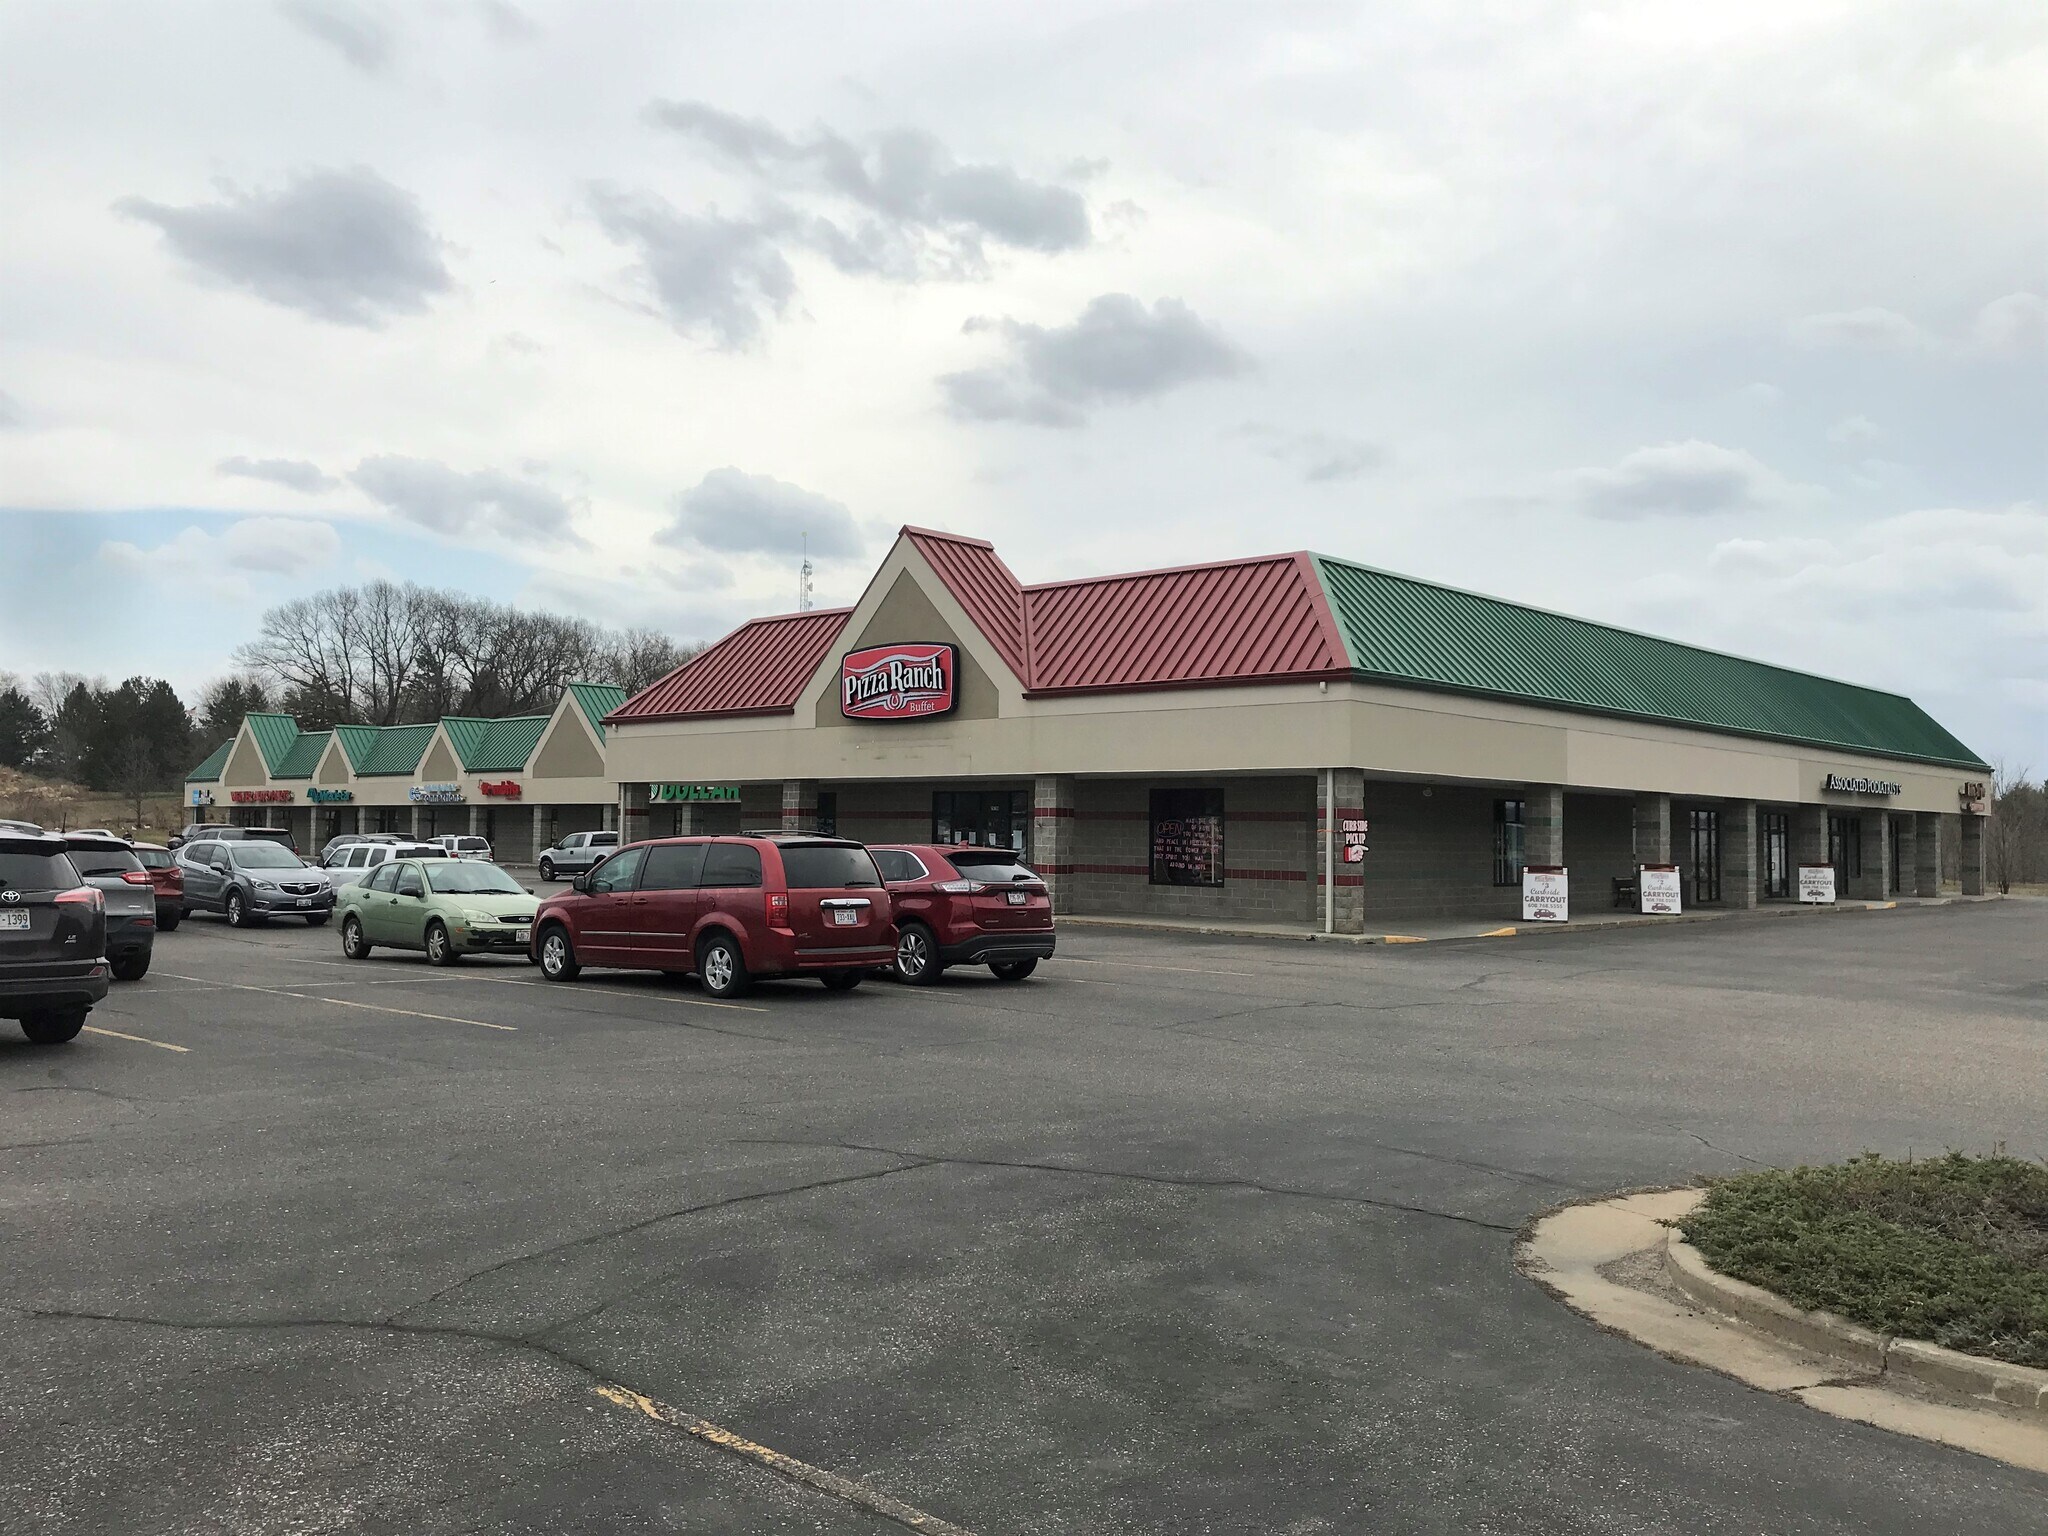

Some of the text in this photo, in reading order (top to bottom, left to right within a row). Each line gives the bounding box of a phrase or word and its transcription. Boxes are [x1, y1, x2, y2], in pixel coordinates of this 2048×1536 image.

[845, 656, 943, 705] Pizza Ranch
[910, 701, 935, 712] Buffet
[1829, 775, 1867, 793] ASSOCIATED
[1158, 822, 1182, 835] OPEN
[0, 914, 28, 925] -1399
